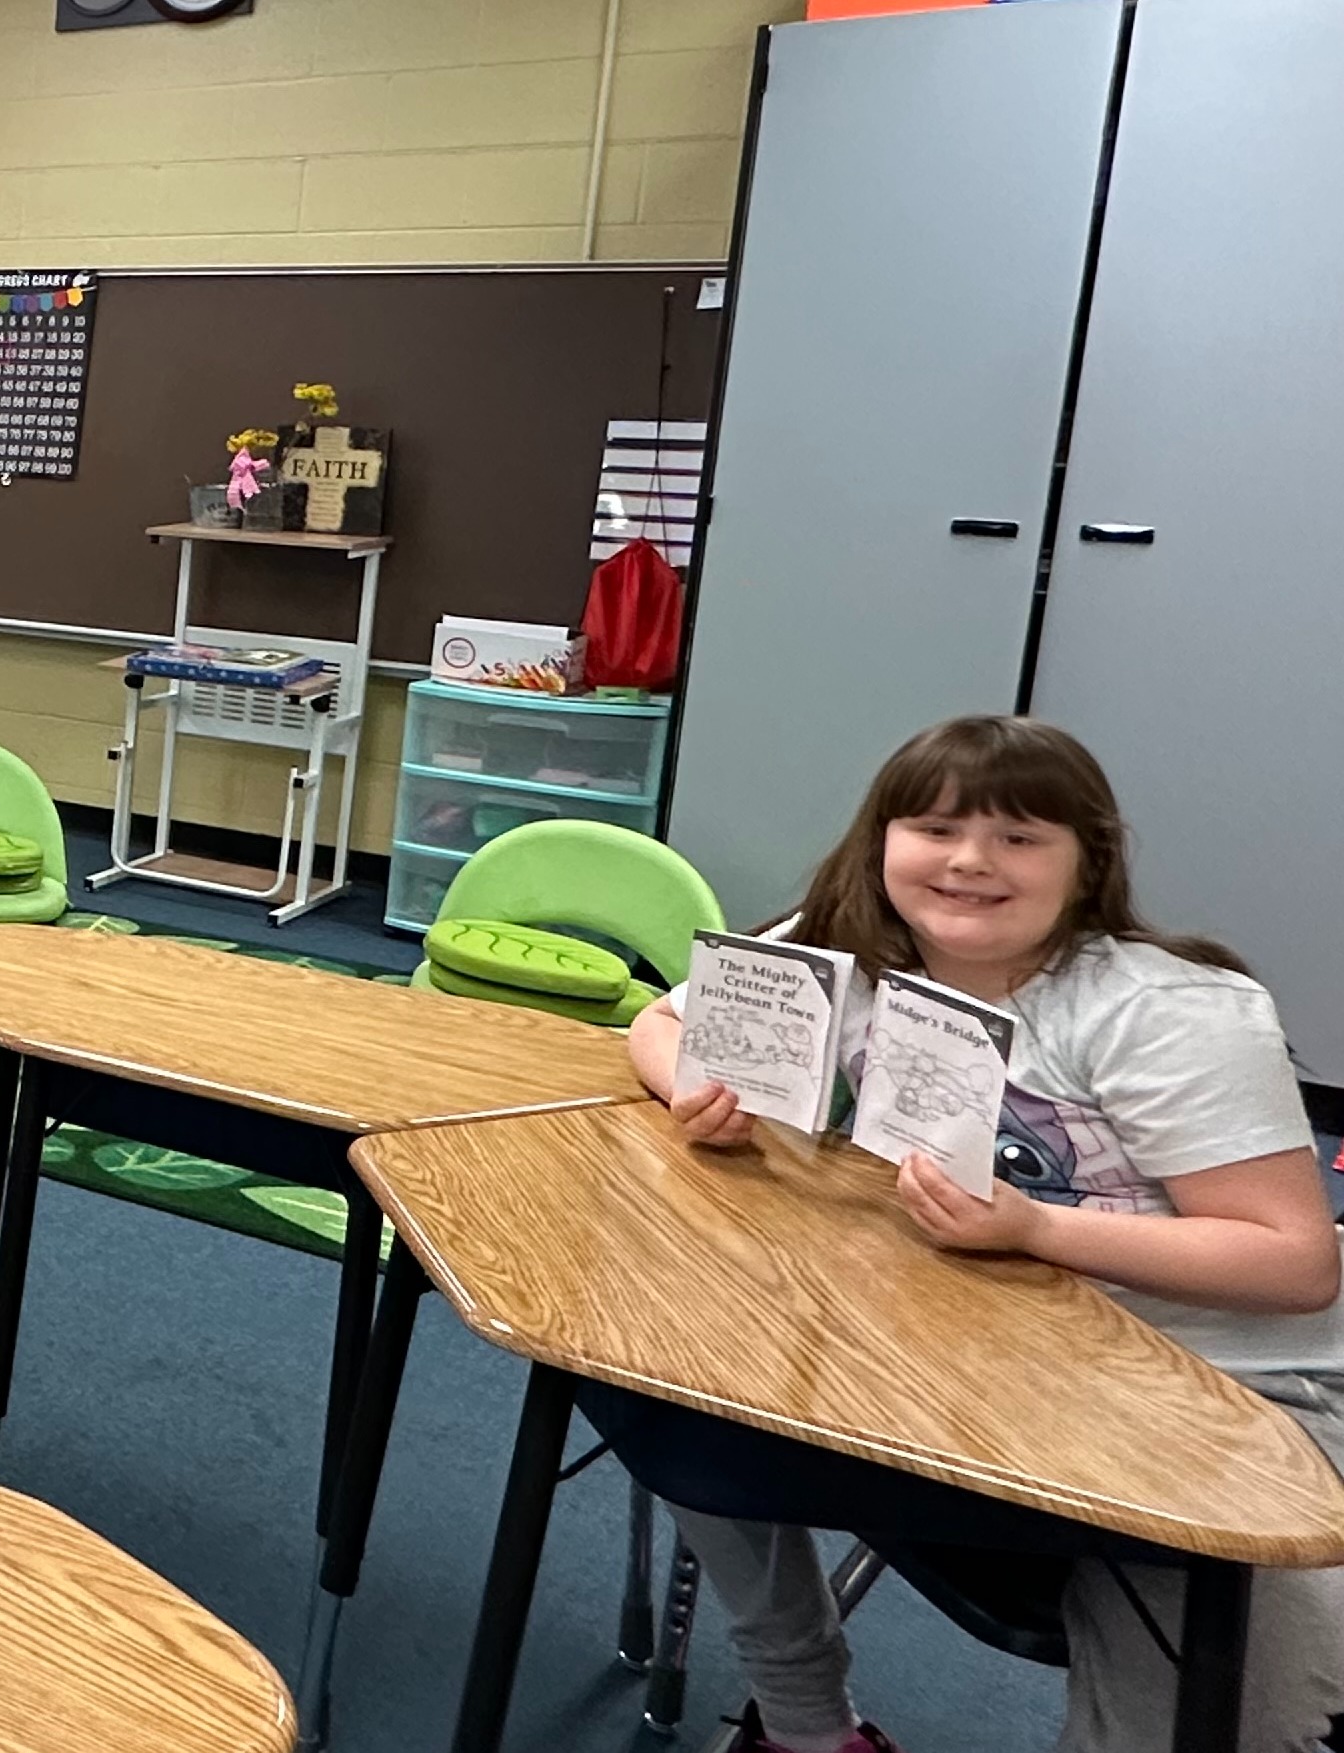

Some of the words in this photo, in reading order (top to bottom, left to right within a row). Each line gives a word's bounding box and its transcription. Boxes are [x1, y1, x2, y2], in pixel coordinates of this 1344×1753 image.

[31, 274, 68, 286] CHART
[291, 459, 368, 480] FAITH
[718, 958, 746, 973] The
[752, 964, 807, 990] Mighty
[724, 974, 778, 995] Critter
[781, 989, 797, 1000] of
[700, 984, 772, 1010] Jellybean
[777, 1001, 815, 1022] Town
[888, 998, 939, 1028] Midge's
[943, 1021, 990, 1048] Bridge
